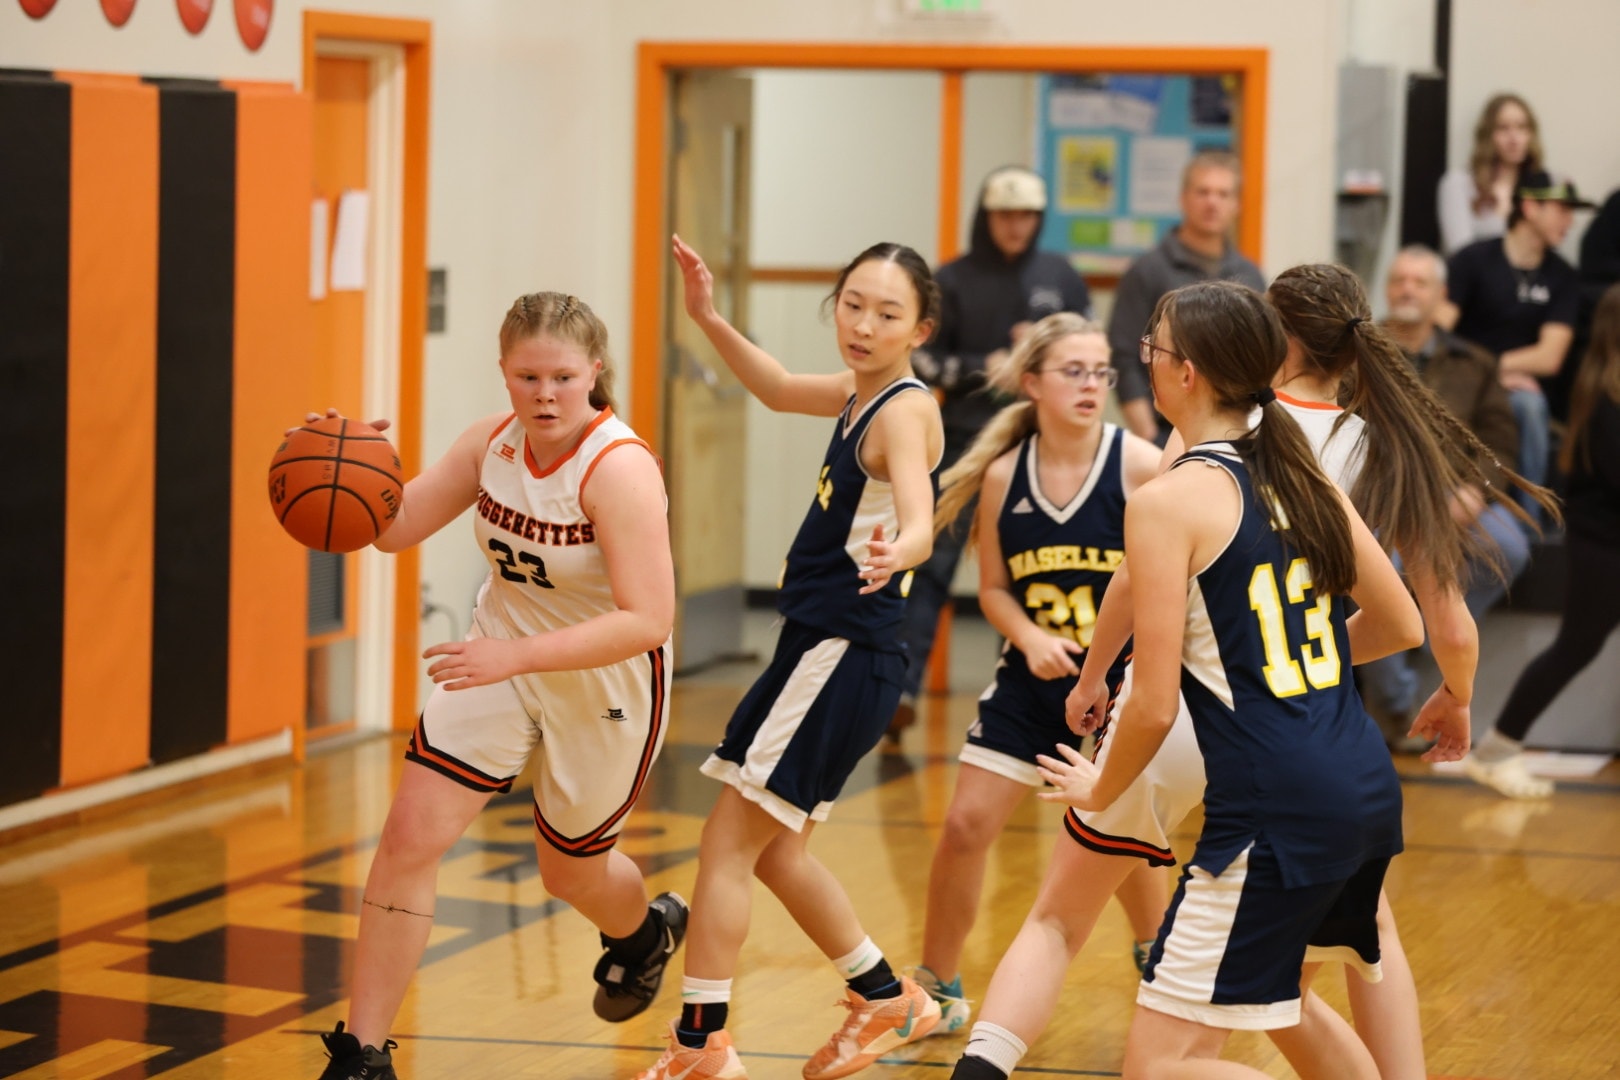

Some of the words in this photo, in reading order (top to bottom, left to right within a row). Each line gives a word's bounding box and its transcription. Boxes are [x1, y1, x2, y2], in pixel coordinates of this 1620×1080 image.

[477, 485, 596, 547] OGGERETTES
[488, 538, 555, 589] 23
[1008, 544, 1125, 581] NASELLE
[1025, 582, 1097, 649] 21
[1248, 557, 1341, 698] 13
